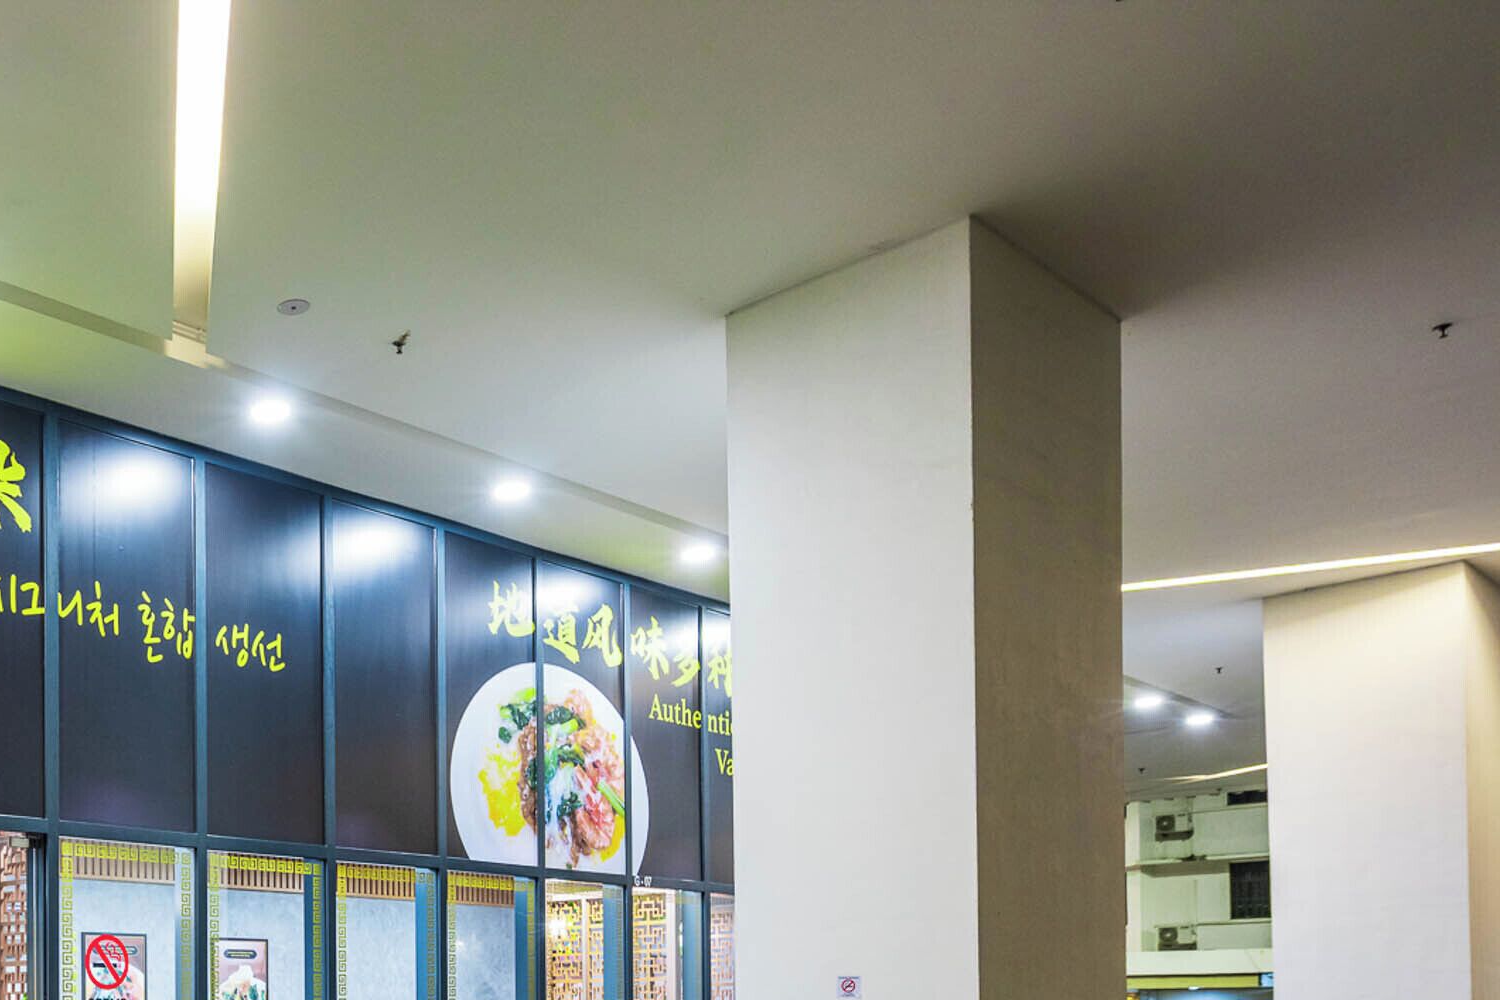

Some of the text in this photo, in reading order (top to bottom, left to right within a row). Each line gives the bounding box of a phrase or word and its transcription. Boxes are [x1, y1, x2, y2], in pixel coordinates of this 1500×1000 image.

[137, 591, 196, 663] 혼합
[215, 623, 286, 672] 생선
[649, 693, 733, 736] Authenti
